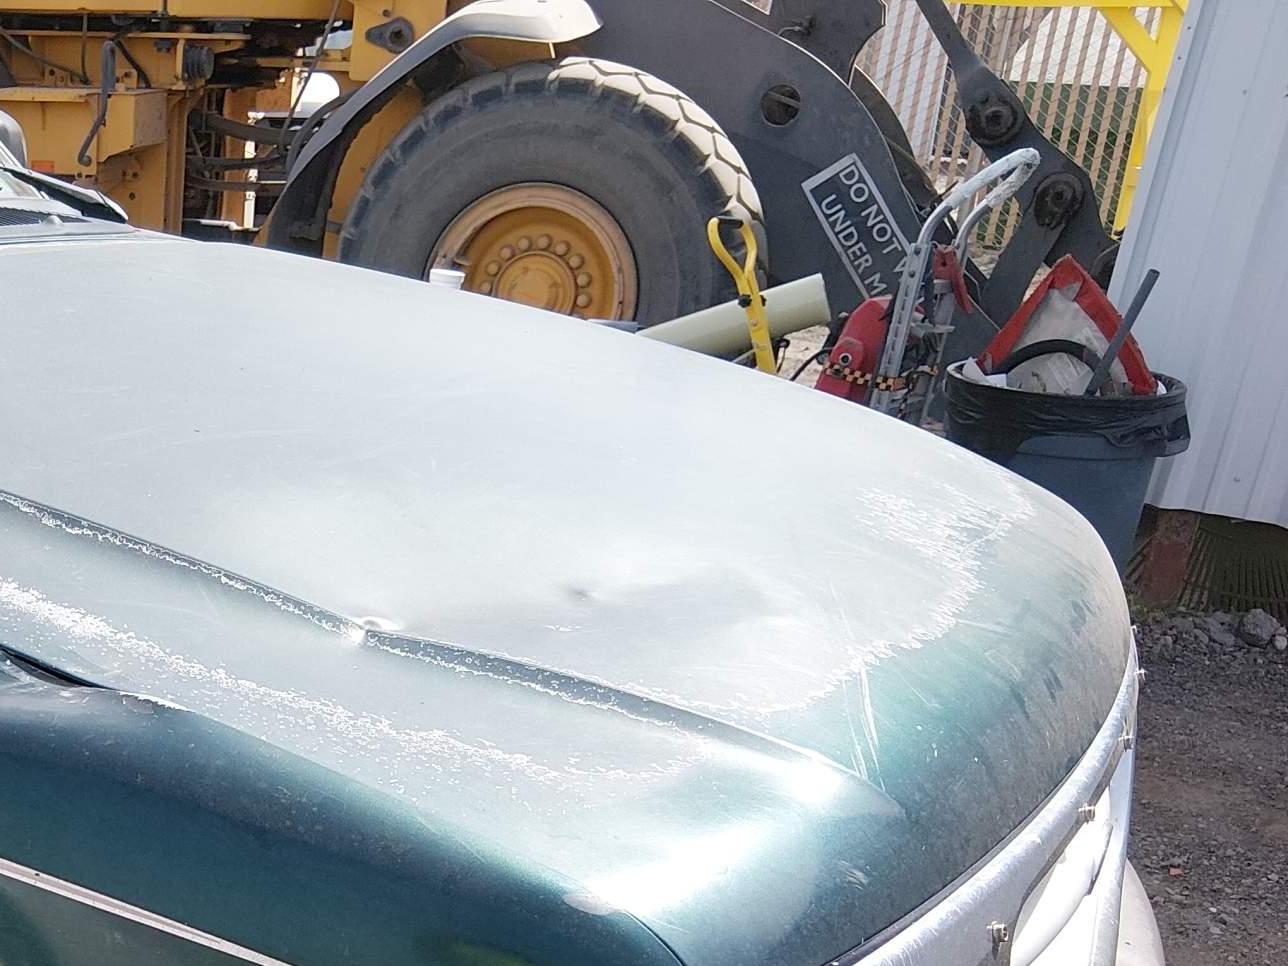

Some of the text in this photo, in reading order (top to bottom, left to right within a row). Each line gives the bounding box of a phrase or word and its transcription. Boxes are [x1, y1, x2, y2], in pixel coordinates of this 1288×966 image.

[821, 193, 873, 274] UNDER
[839, 164, 868, 203] DO
[861, 204, 902, 255] NOT
